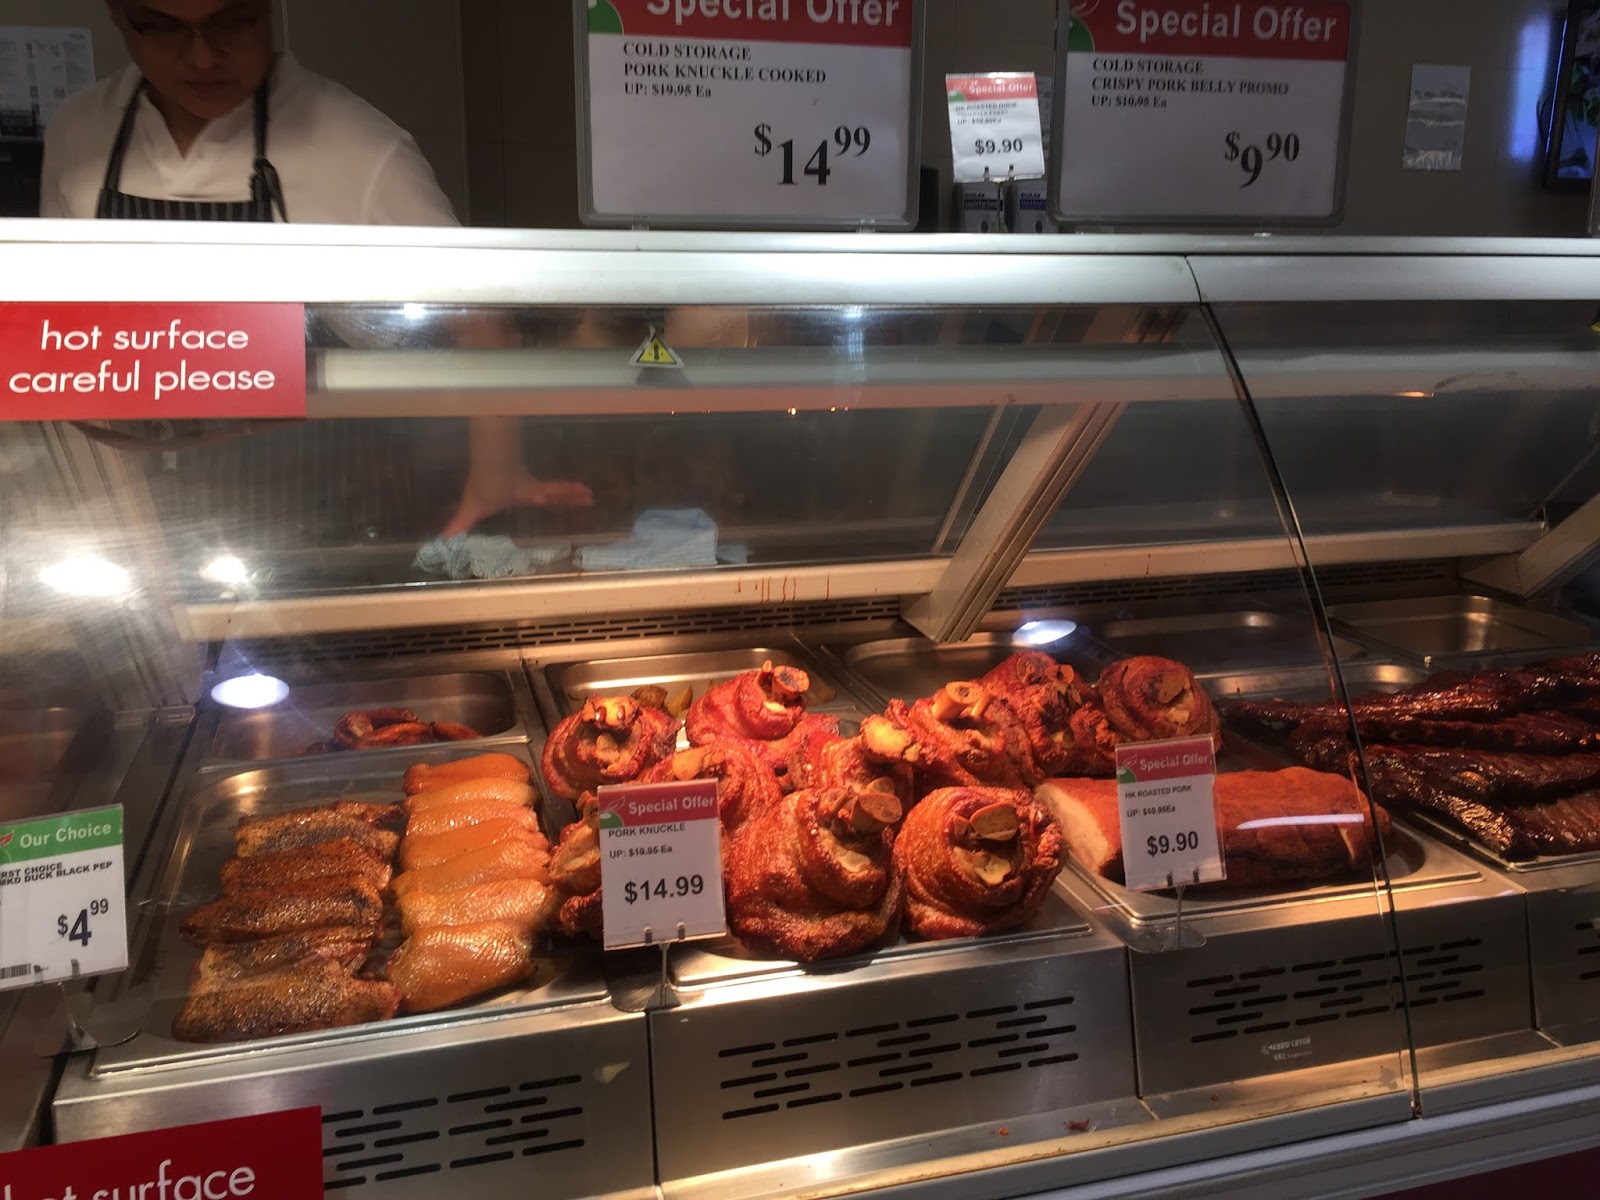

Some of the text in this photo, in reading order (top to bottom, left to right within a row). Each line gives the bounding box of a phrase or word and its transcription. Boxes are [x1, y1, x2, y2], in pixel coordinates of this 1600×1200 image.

[1115, 0, 1338, 43] Special Offer
[623, 41, 751, 62] COLD STORAGE
[624, 63, 826, 85] PORK KNUCKLE COOKED
[1092, 58, 1204, 75] COLD STORAGE
[624, 83, 649, 96] UP:
[695, 85, 712, 98] Ea
[969, 82, 1033, 96] Special Offer
[1092, 77, 1289, 96] CRISPY PORK BELLY PROMO
[1091, 94, 1112, 108] UP:
[1153, 96, 1167, 108] Ea
[975, 138, 1024, 155] $9.90
[40, 319, 249, 351] hot surface
[8, 359, 276, 401] careful please
[1139, 753, 1208, 772] Special Offer
[1137, 787, 1172, 799] ROASTED
[1172, 785, 1191, 794] PORK
[628, 796, 714, 816] Special Offer
[19, 822, 112, 849] Our Choice
[608, 823, 686, 838] PORK KNUCKLE
[1146, 830, 1200, 858] $9.90
[609, 850, 627, 859] UP:
[24, 863, 63, 874] CHOICE
[24, 872, 54, 884] DUCK
[56, 866, 91, 878] BLACK
[93, 861, 113, 871] PEP
[624, 874, 705, 906] $14.99
